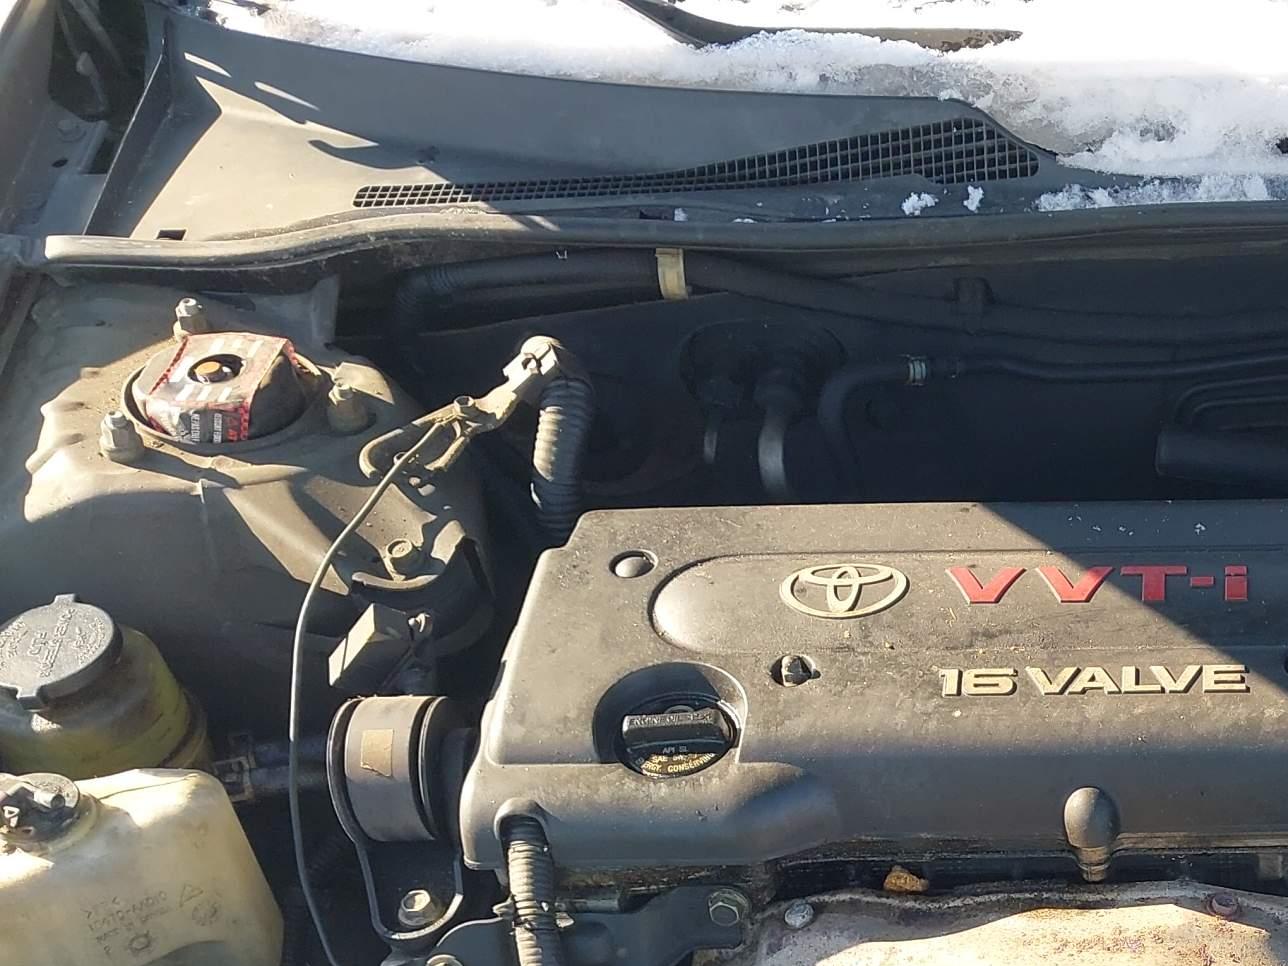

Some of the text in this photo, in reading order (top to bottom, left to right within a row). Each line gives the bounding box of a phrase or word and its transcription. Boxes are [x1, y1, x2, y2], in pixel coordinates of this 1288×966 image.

[946, 565, 1250, 604] VVT-i
[939, 664, 1251, 696] 16 VALVE
